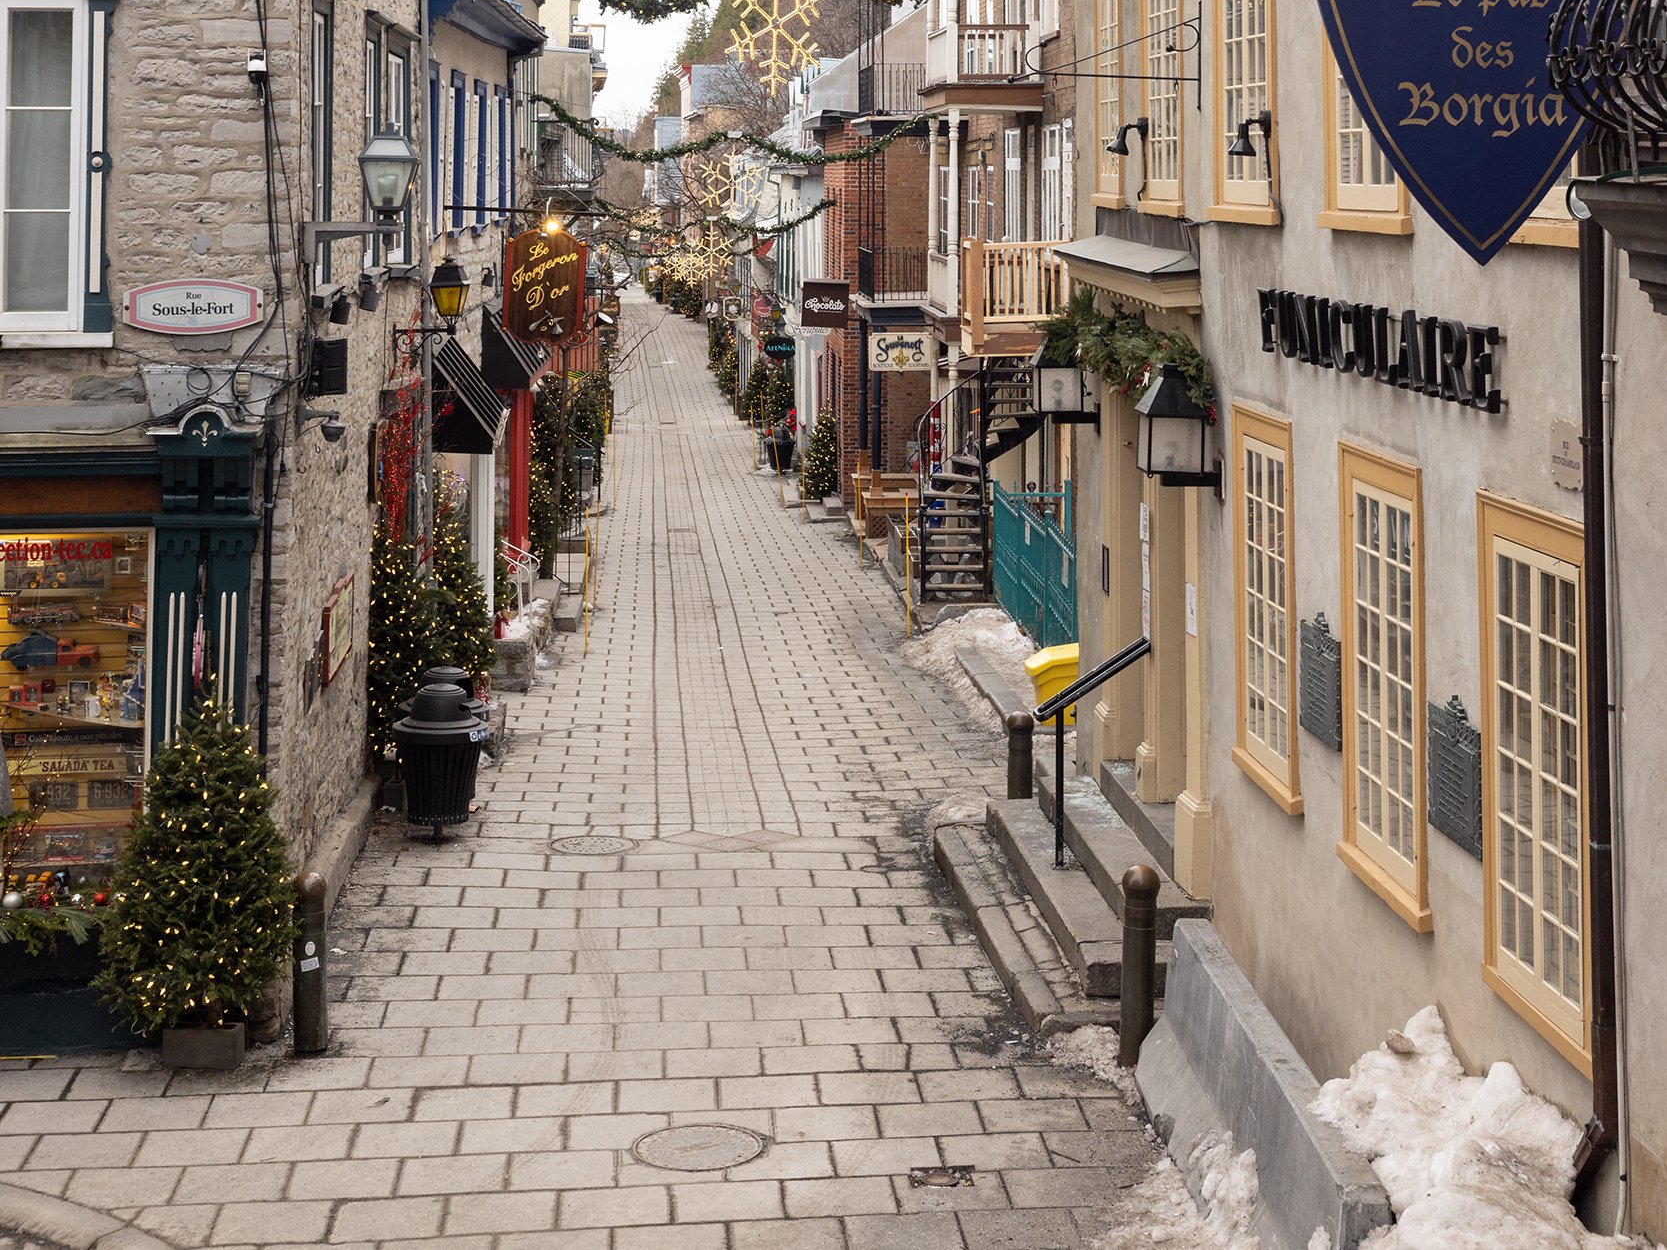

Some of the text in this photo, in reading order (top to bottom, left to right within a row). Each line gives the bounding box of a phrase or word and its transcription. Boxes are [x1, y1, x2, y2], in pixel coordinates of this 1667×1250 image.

[1451, 26, 1514, 69] des
[1398, 77, 1568, 137] Borgia
[529, 242, 549, 261] Le
[511, 252, 579, 292] Forgeron
[152, 302, 234, 316] Sous-le-Fort
[185, 291, 202, 300] Rue
[1257, 287, 1501, 413] FUNICULAIRE
[93, 760, 114, 770] TEA
